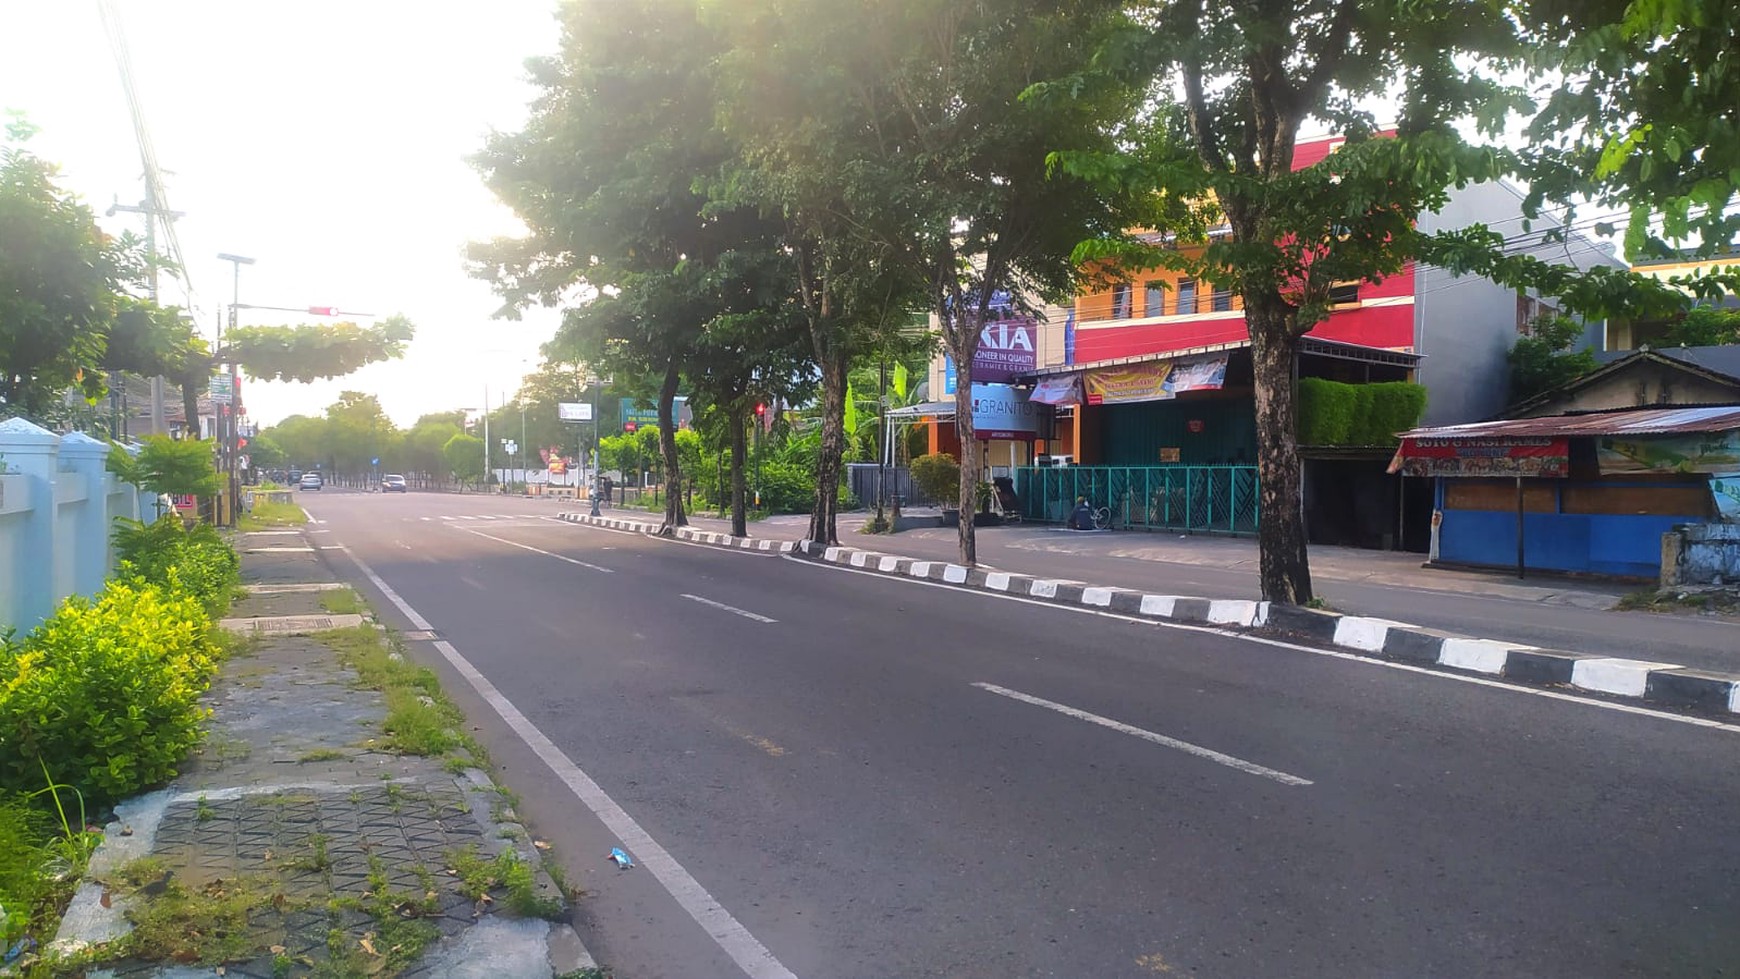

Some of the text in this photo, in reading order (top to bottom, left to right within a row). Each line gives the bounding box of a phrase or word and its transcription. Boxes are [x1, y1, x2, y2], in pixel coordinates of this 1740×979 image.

[999, 353, 1007, 361] IN
[1008, 354, 1034, 364] QUALITY
[980, 399, 1033, 416] GRANITO
